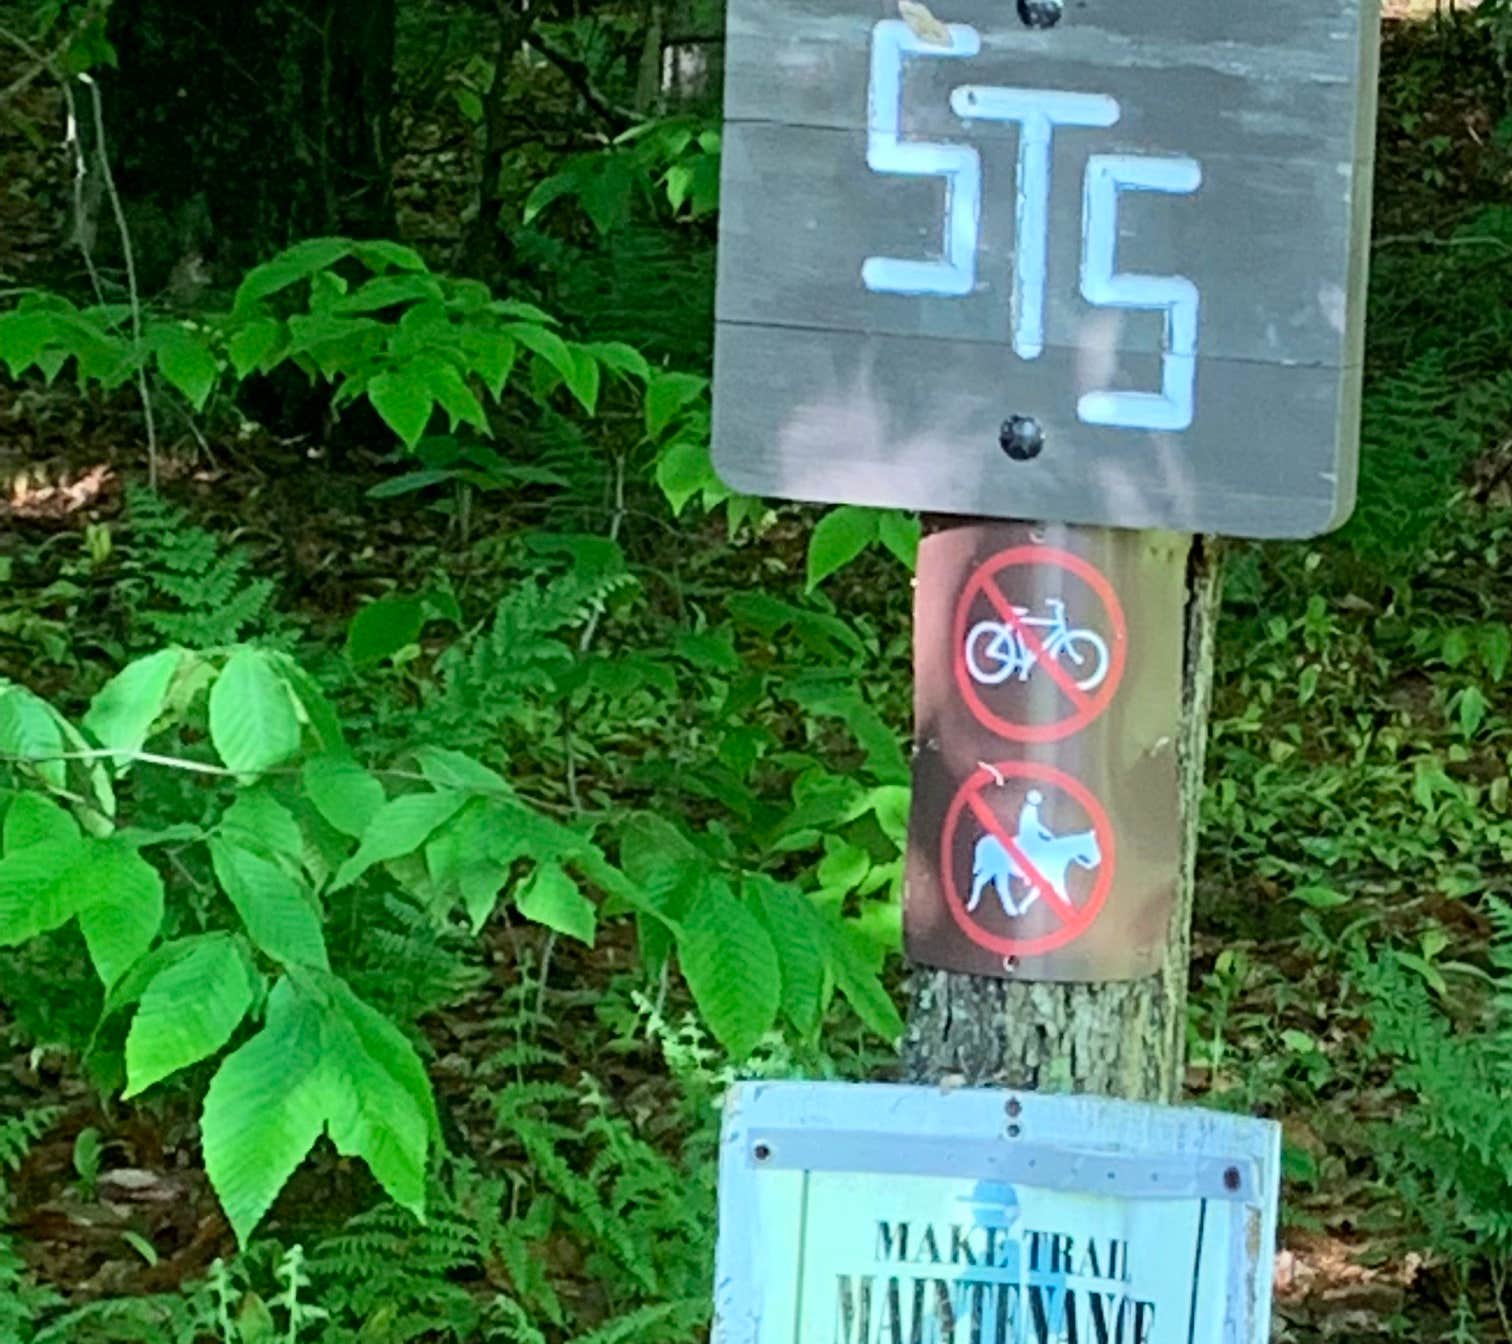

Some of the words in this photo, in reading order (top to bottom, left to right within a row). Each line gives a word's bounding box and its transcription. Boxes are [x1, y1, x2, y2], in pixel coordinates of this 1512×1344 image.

[861, 19, 1201, 430] STS
[875, 1220, 1009, 1269] MAKE
[1023, 1229, 1132, 1284] TRAIL
